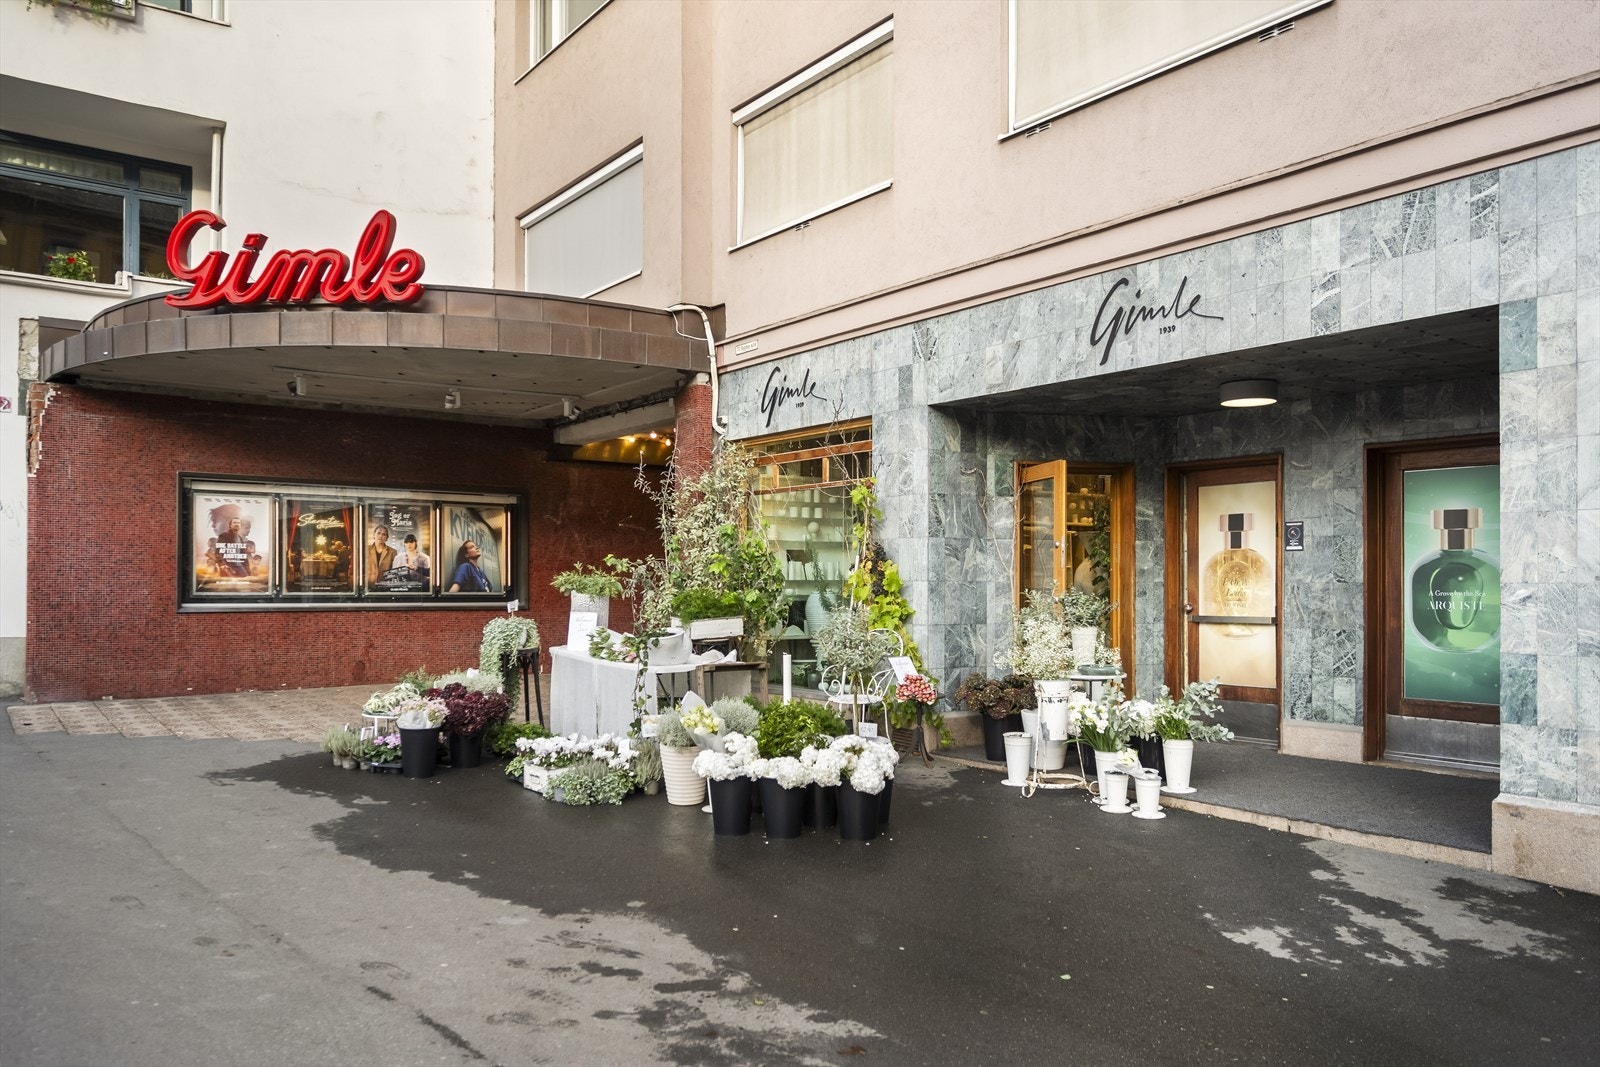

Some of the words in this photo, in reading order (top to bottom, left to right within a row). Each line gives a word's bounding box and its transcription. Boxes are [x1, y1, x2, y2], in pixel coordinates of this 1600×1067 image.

[164, 209, 426, 311] Gimle
[1090, 275, 1224, 366] Gimle
[1159, 325, 1176, 335] 1939
[761, 366, 828, 428] Gimle
[391, 518, 413, 527] Maria
[1427, 601, 1487, 612] ARQUISTE
